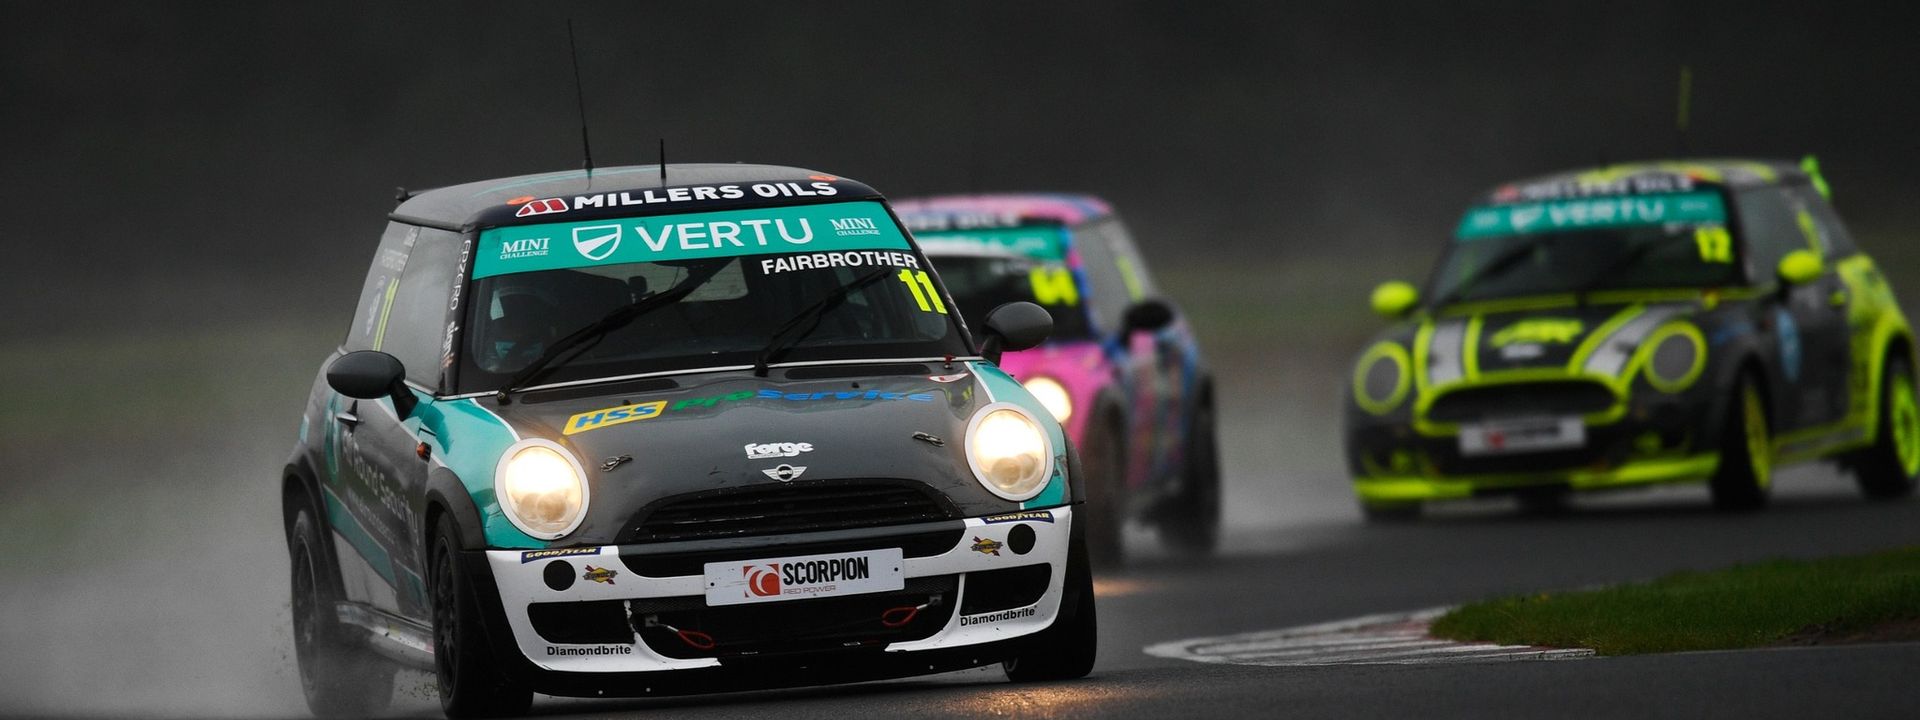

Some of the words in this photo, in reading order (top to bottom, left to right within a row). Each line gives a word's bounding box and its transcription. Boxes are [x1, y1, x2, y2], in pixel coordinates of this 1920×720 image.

[573, 185, 744, 209] MILLERS
[752, 182, 838, 198] OILS
[829, 218, 878, 231] MINI
[836, 229, 880, 237] CHALLENGE
[635, 218, 814, 251] VERTU
[501, 237, 550, 254] MINI
[500, 250, 549, 260] CHALLENGE
[761, 251, 920, 275] FAIRBROTHER
[898, 268, 948, 314] 11
[575, 405, 657, 428] HSS
[986, 512, 1050, 522] GOODYEAR
[525, 547, 598, 559] GOODYEAR
[782, 556, 870, 586] SCORPION
[803, 584, 836, 593] POWER
[960, 607, 1036, 627] Diamondbrite
[546, 645, 632, 656] Diamondbrite
